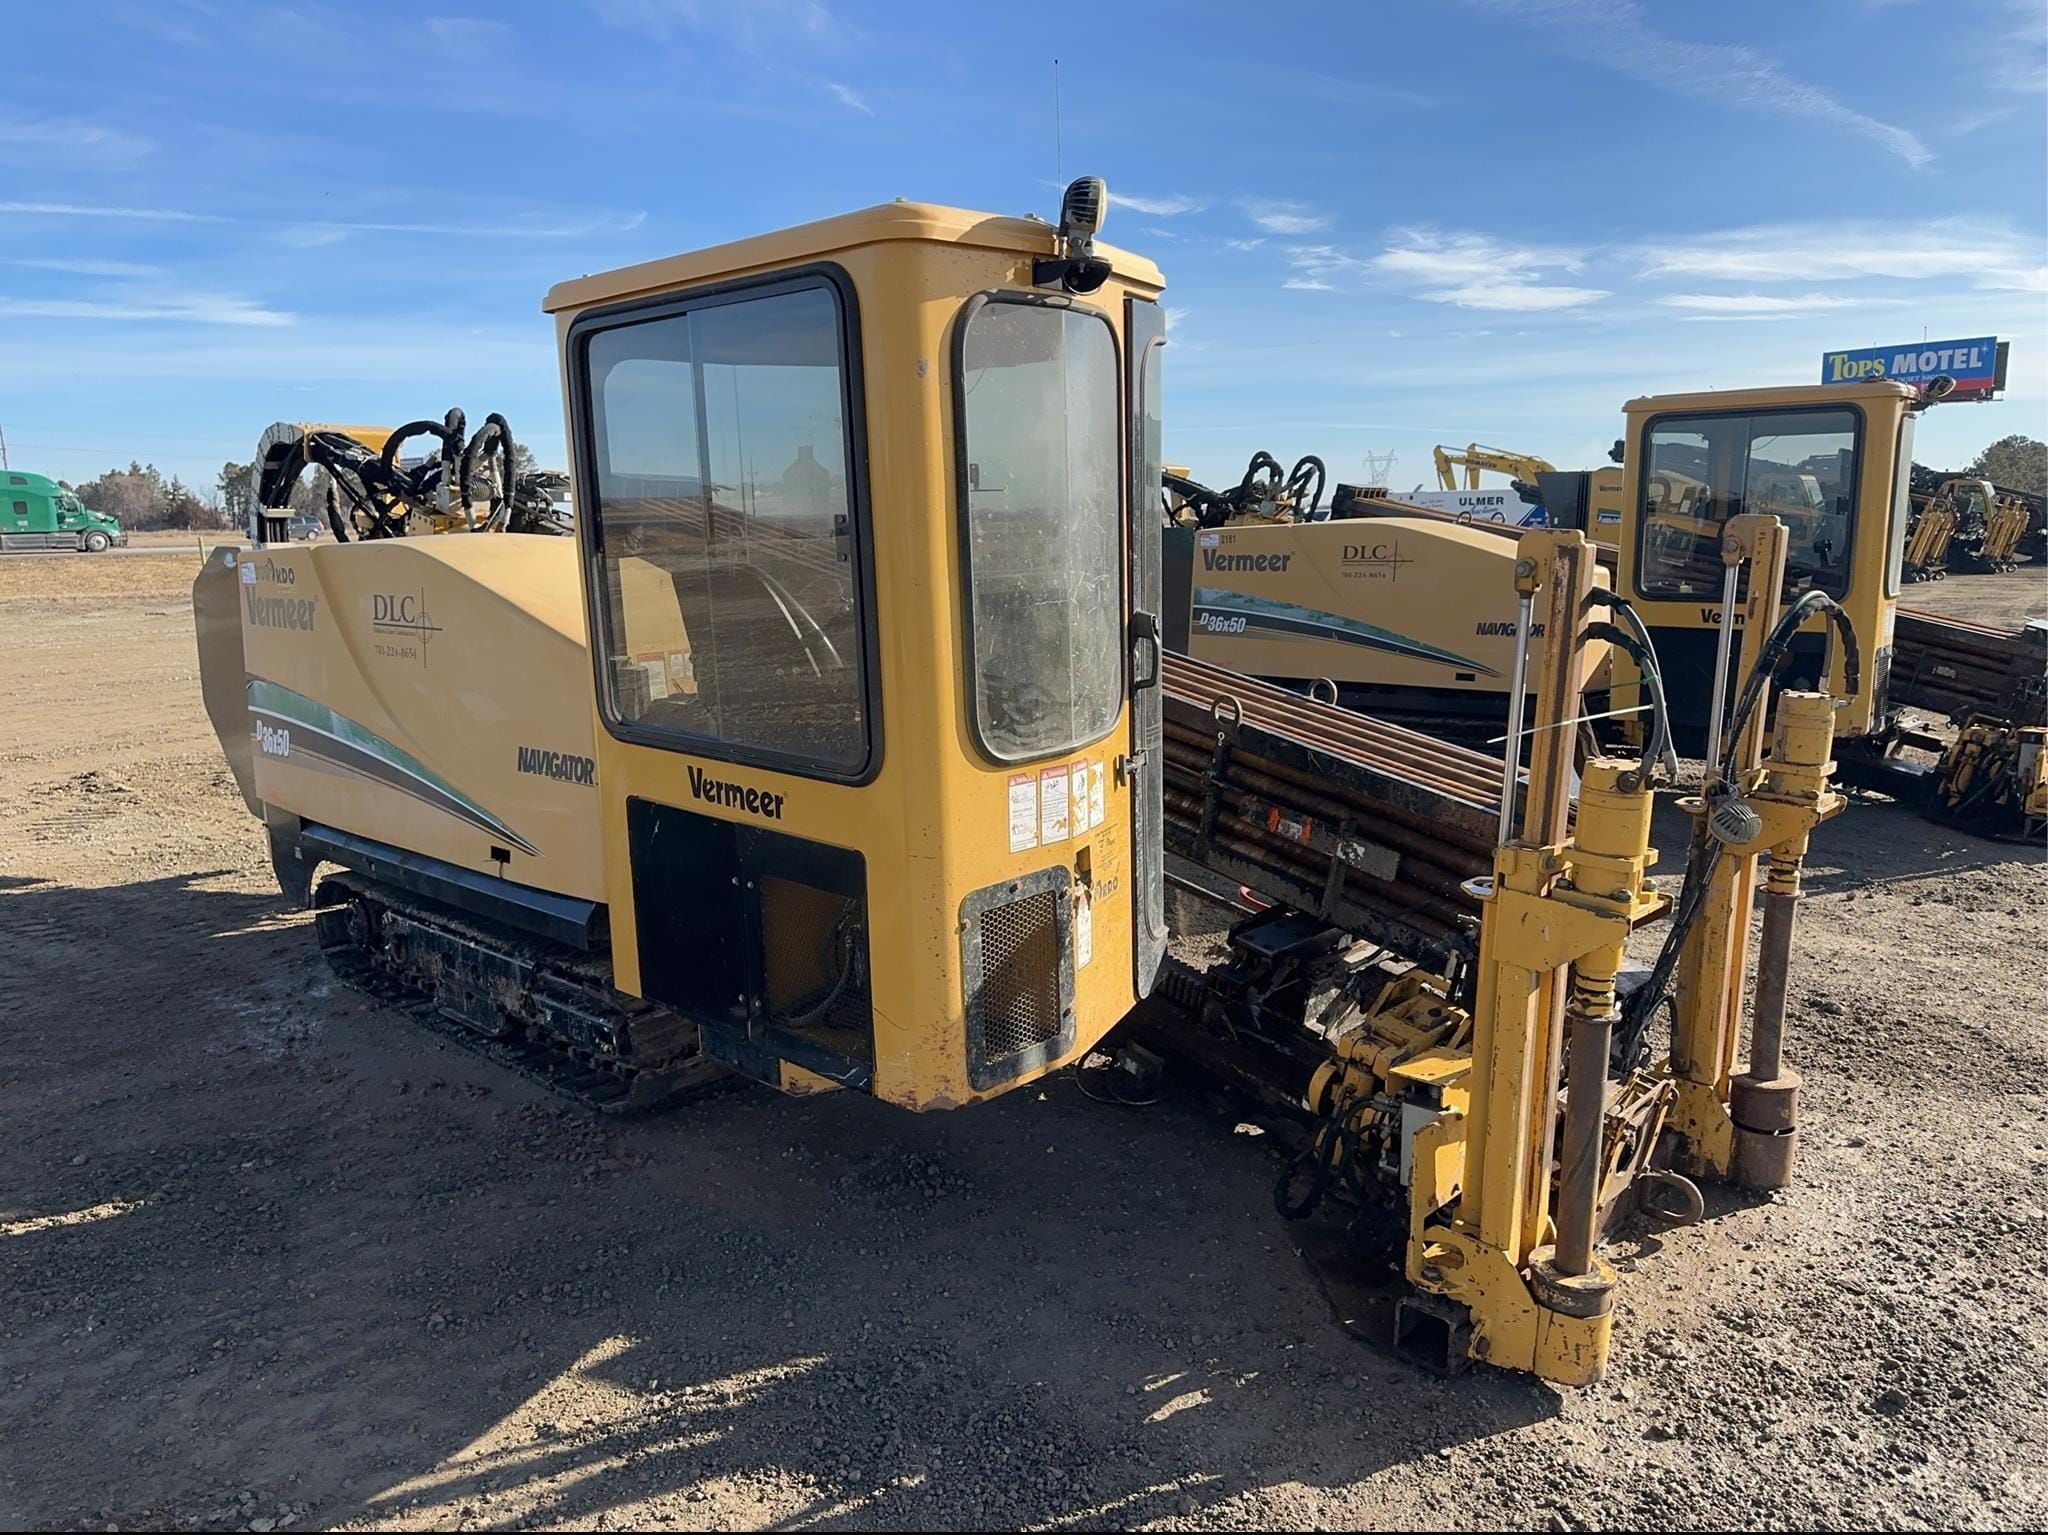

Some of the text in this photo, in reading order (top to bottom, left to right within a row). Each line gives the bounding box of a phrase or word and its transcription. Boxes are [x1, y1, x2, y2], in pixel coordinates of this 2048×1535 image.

[1891, 347, 1983, 375] MOTEL
[1459, 496, 1504, 506] ULMER
[1203, 548, 1291, 572] Vermeer
[1343, 544, 1387, 560] DLC
[244, 585, 315, 632] Vermeer
[373, 594, 416, 624] DLC
[1200, 612, 1247, 633] D36x50
[517, 745, 595, 785] NAVIGATOR
[687, 764, 784, 820] Vermeer
